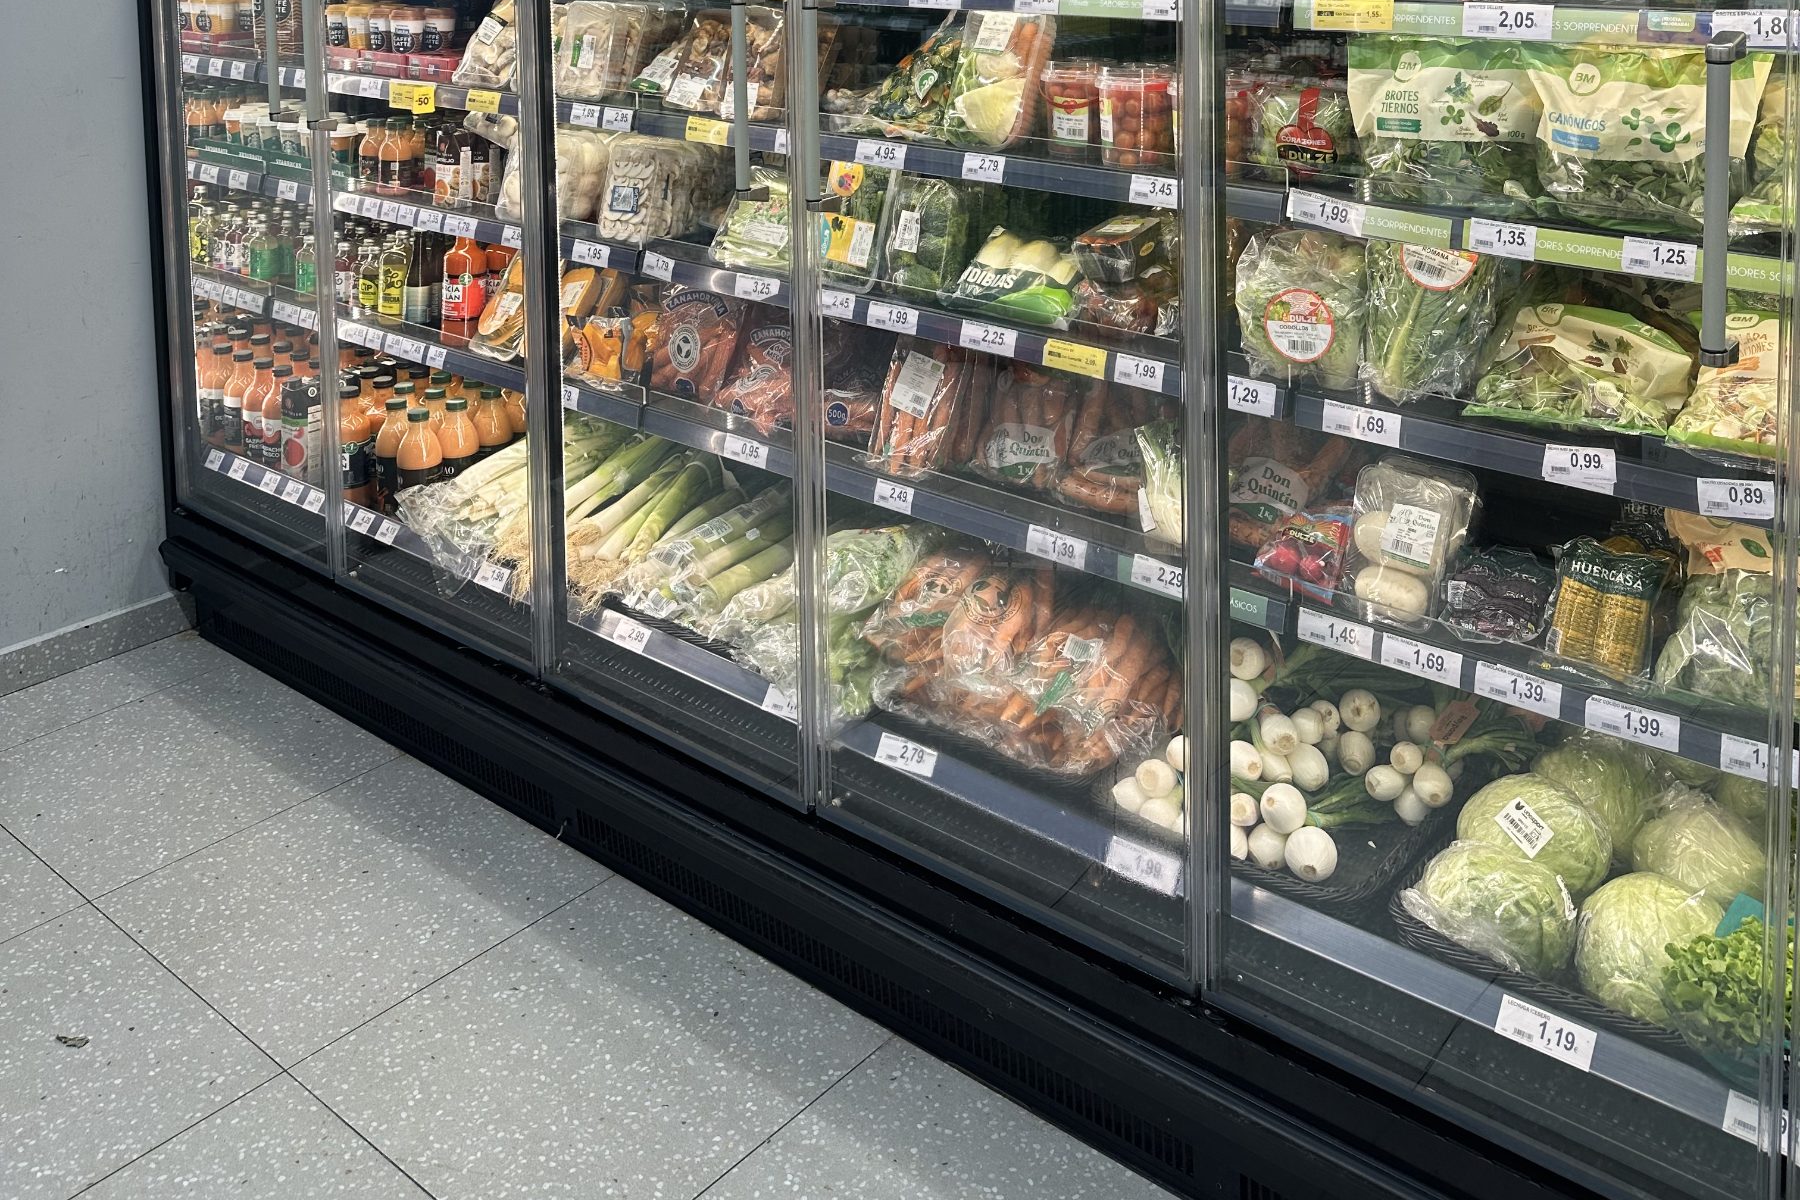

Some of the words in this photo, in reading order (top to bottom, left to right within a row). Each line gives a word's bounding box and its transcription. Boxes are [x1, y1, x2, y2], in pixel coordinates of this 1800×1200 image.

[1393, 13, 1456, 25] ORPRENDENTES
[1563, 21, 1637, 33] SORPRENDENTE
[1399, 61, 1417, 71] BM
[1574, 72, 1595, 84] BM
[1385, 90, 1419, 102] BROTES
[1381, 102, 1419, 114] TIERNOS
[1281, 135, 1327, 146] CORAZONES
[1377, 217, 1449, 239] SORPRENDENTES
[1536, 240, 1563, 251] ORES
[1566, 243, 1622, 259] SORPRENDE
[1727, 266, 1766, 280] ABORES
[1541, 306, 1559, 315] BM
[1262, 466, 1291, 489] Don
[1623, 502, 1663, 516] HUERC
[1571, 560, 1643, 591] HUERCASA
[1230, 596, 1257, 613] ÁSICOS
[1507, 999, 1530, 1014] LECHUGA
